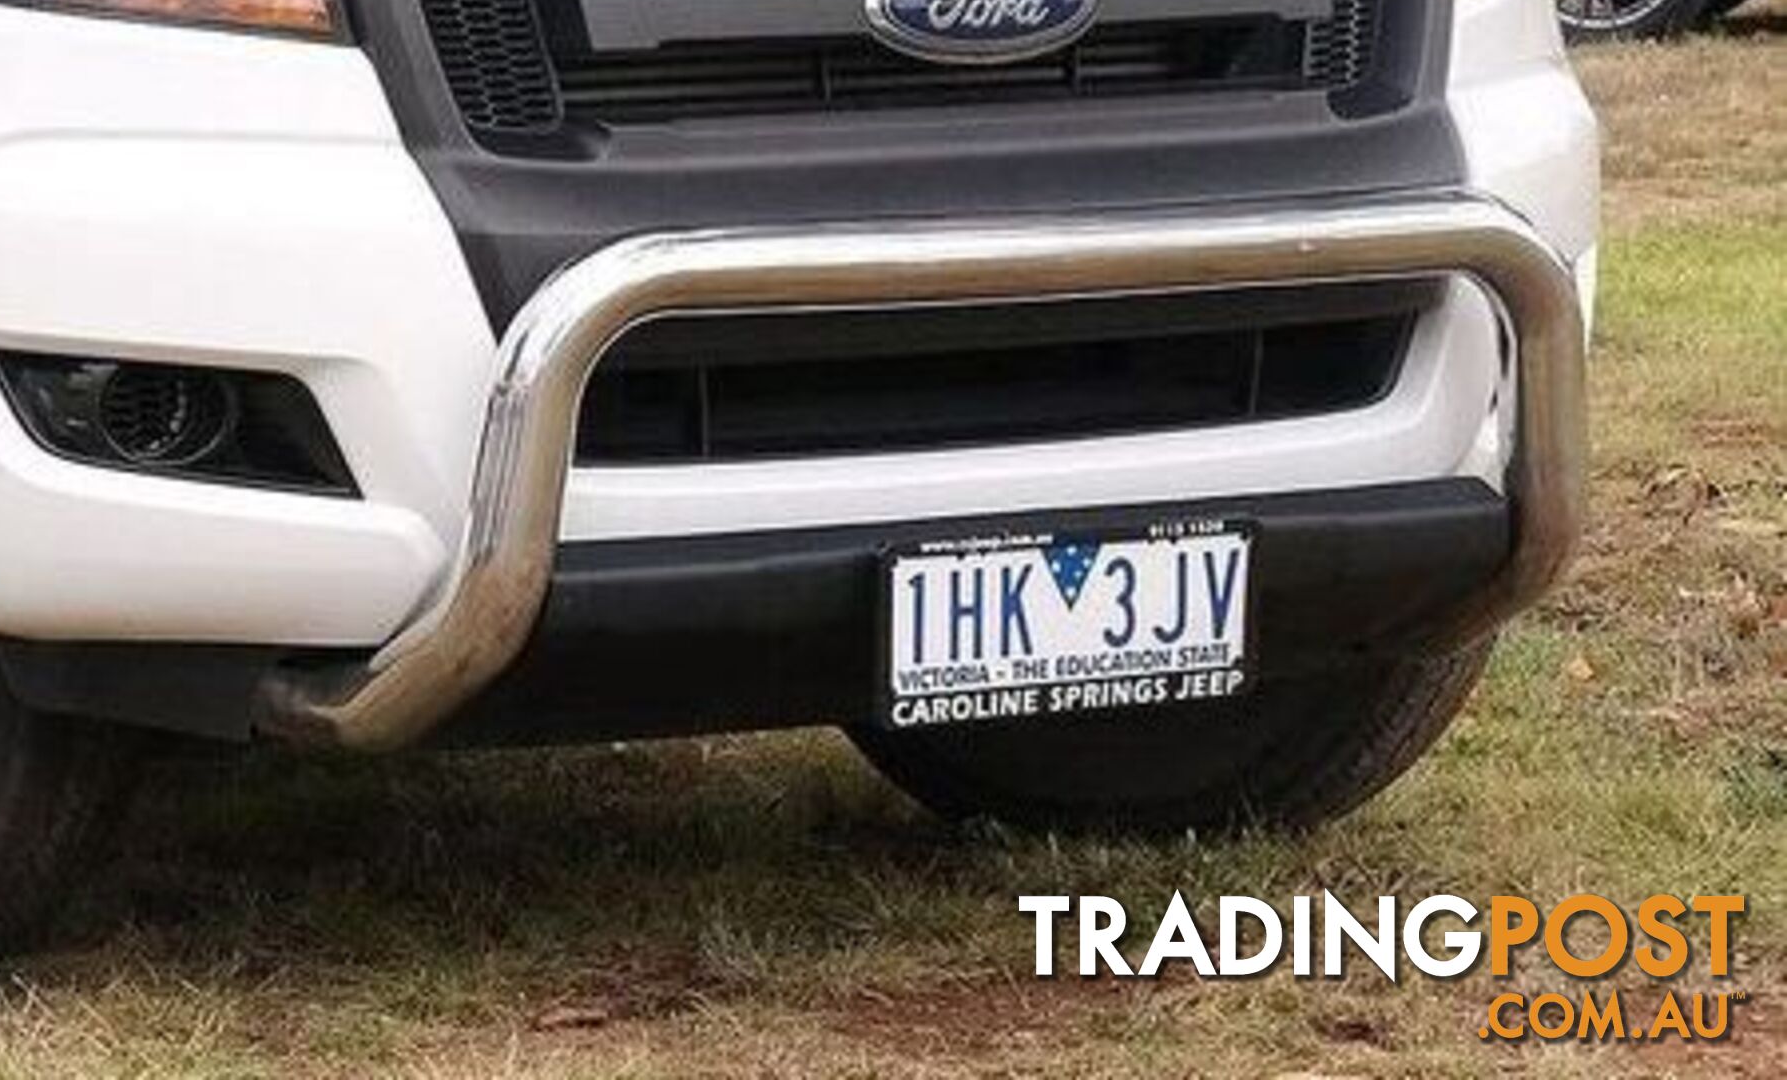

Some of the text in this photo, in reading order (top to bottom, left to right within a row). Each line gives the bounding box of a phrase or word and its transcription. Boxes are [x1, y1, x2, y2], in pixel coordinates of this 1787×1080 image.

[908, 550, 1240, 664] 1HK 3JV
[898, 664, 990, 691] VICTORIA
[1012, 658, 1050, 680] THE
[1055, 648, 1173, 676] EDUCATION
[1178, 643, 1231, 666] STATE
[891, 671, 1244, 726] CAROLINE SPRINGS JEEP
